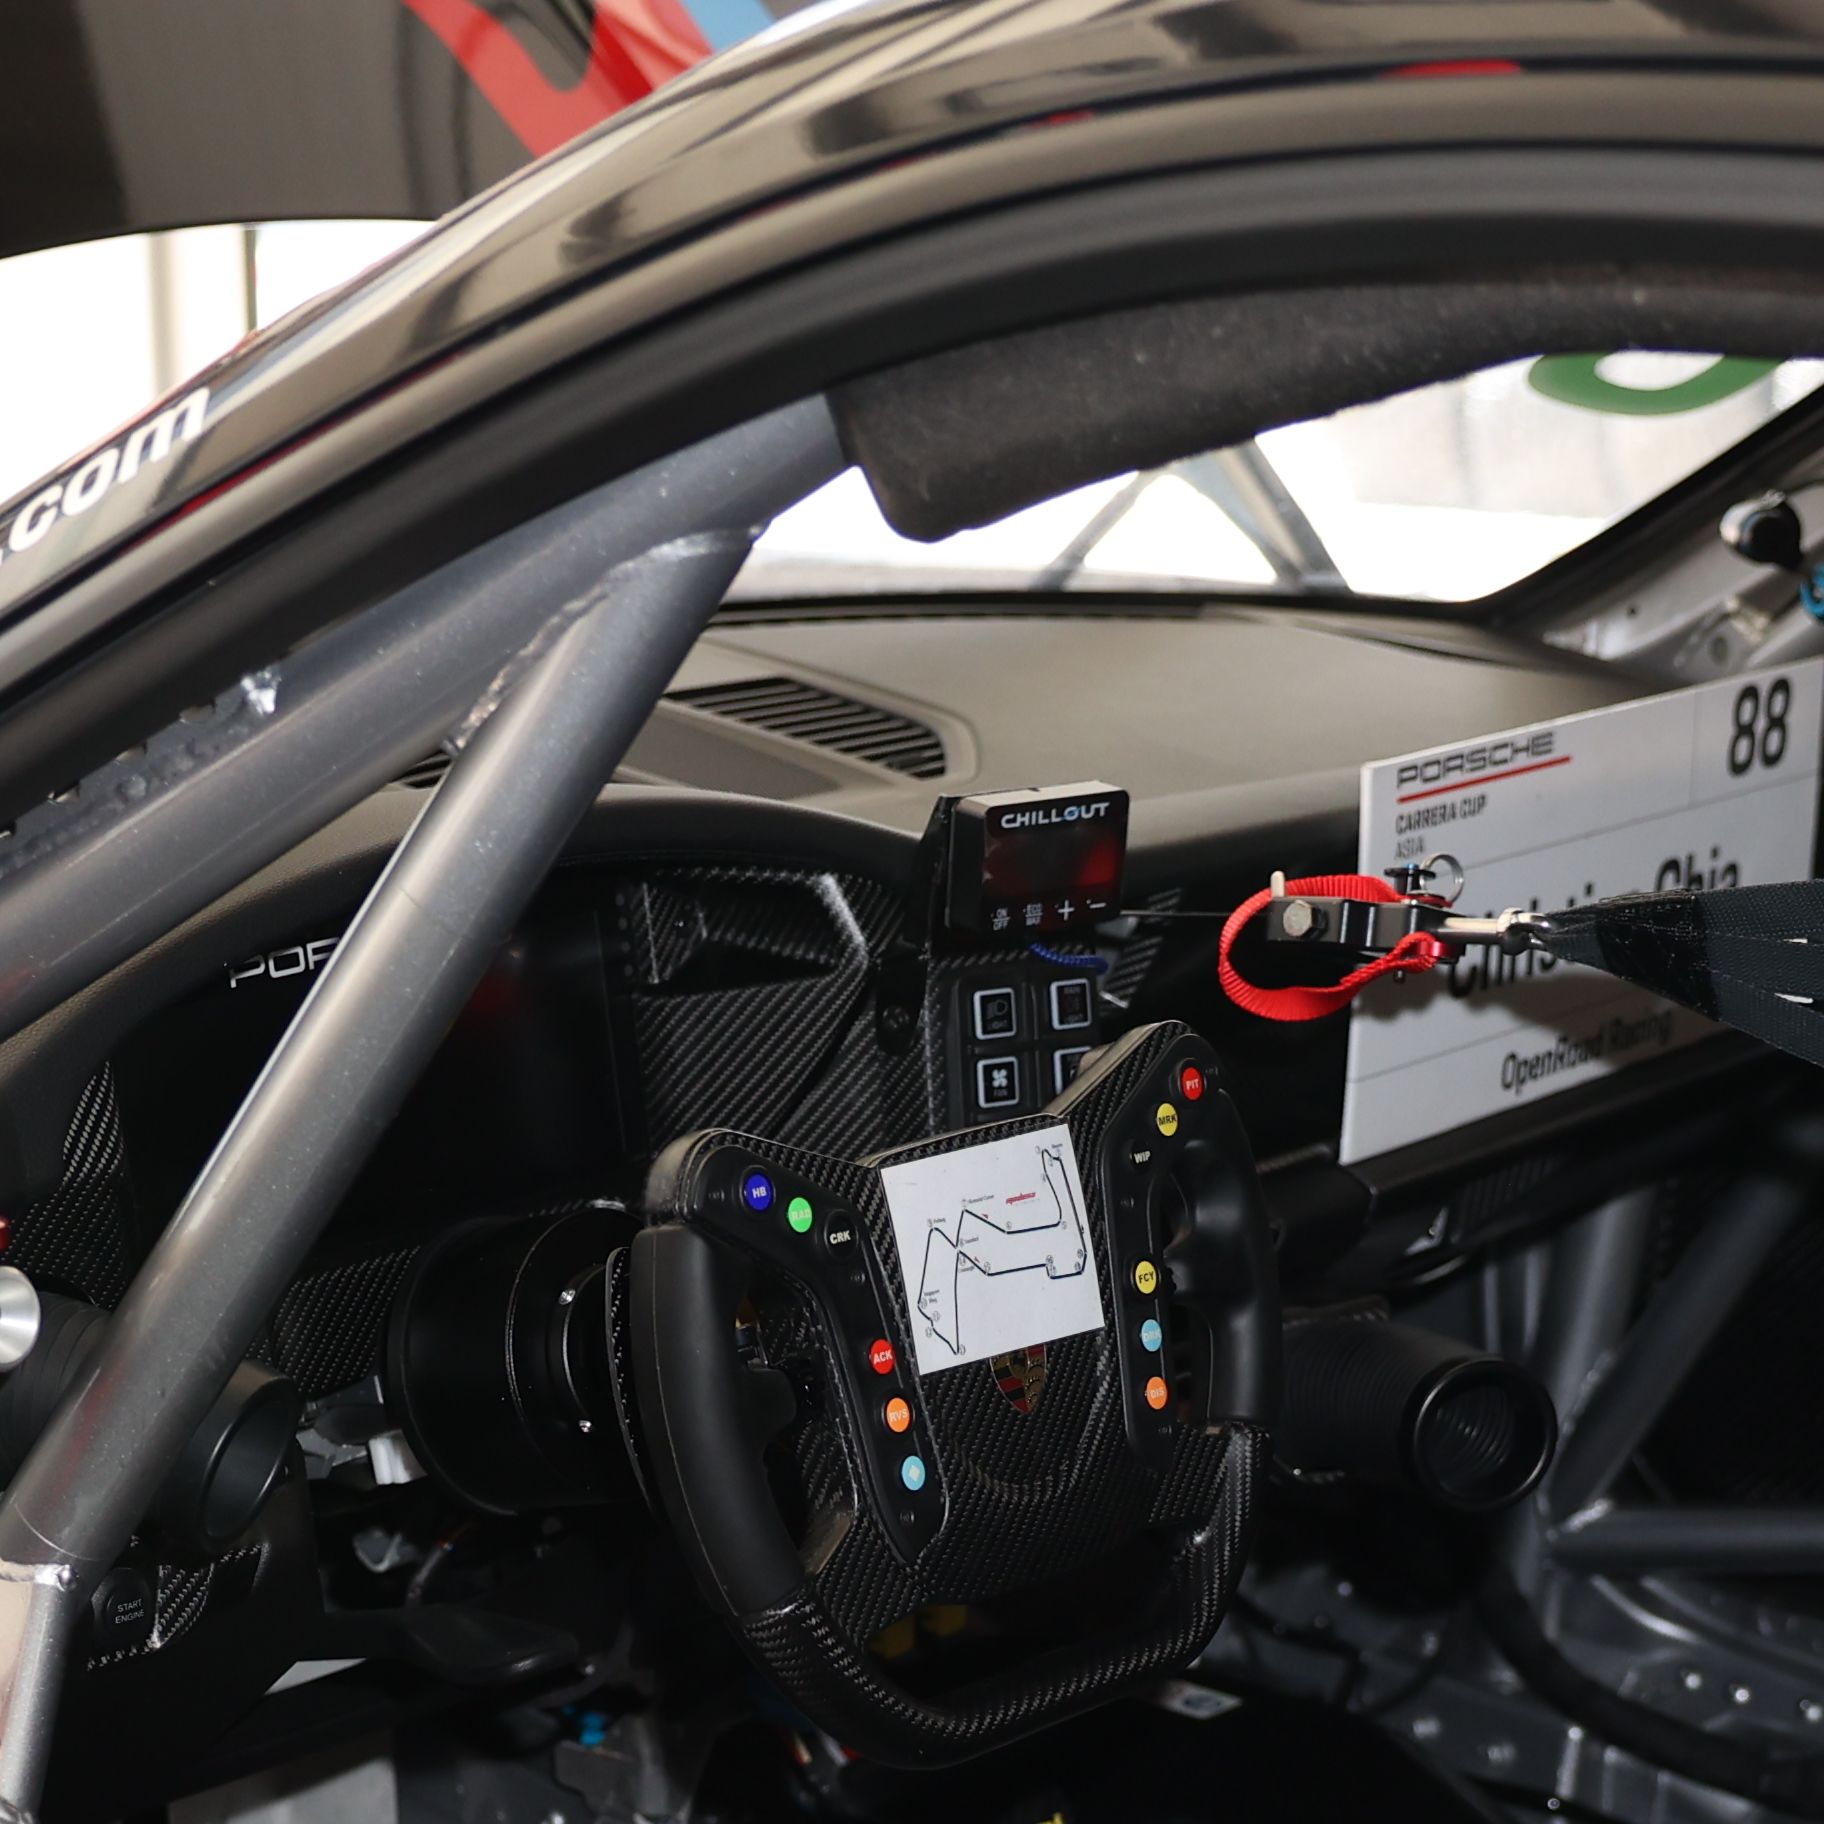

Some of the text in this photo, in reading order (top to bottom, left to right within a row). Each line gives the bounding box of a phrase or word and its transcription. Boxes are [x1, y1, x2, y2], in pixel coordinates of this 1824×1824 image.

[1726, 678, 1792, 778] 88
[1396, 732, 1555, 790] PORSCHE
[1000, 802, 1111, 830] CHILLOUT
[1394, 794, 1489, 836] CARRERA CUP
[1394, 835, 1426, 861] ASIA
[1185, 1078, 1199, 1091] PIT
[1158, 1113, 1177, 1127] MRK
[1133, 1150, 1151, 1164] WIP
[751, 1186, 767, 1199] HB
[829, 1229, 852, 1245] CRK
[1137, 1270, 1156, 1284] FCY
[872, 1349, 894, 1365] ACK
[888, 1407, 909, 1421] RVS
[117, 1598, 143, 1613] START
[115, 1608, 145, 1625] ENGINE
